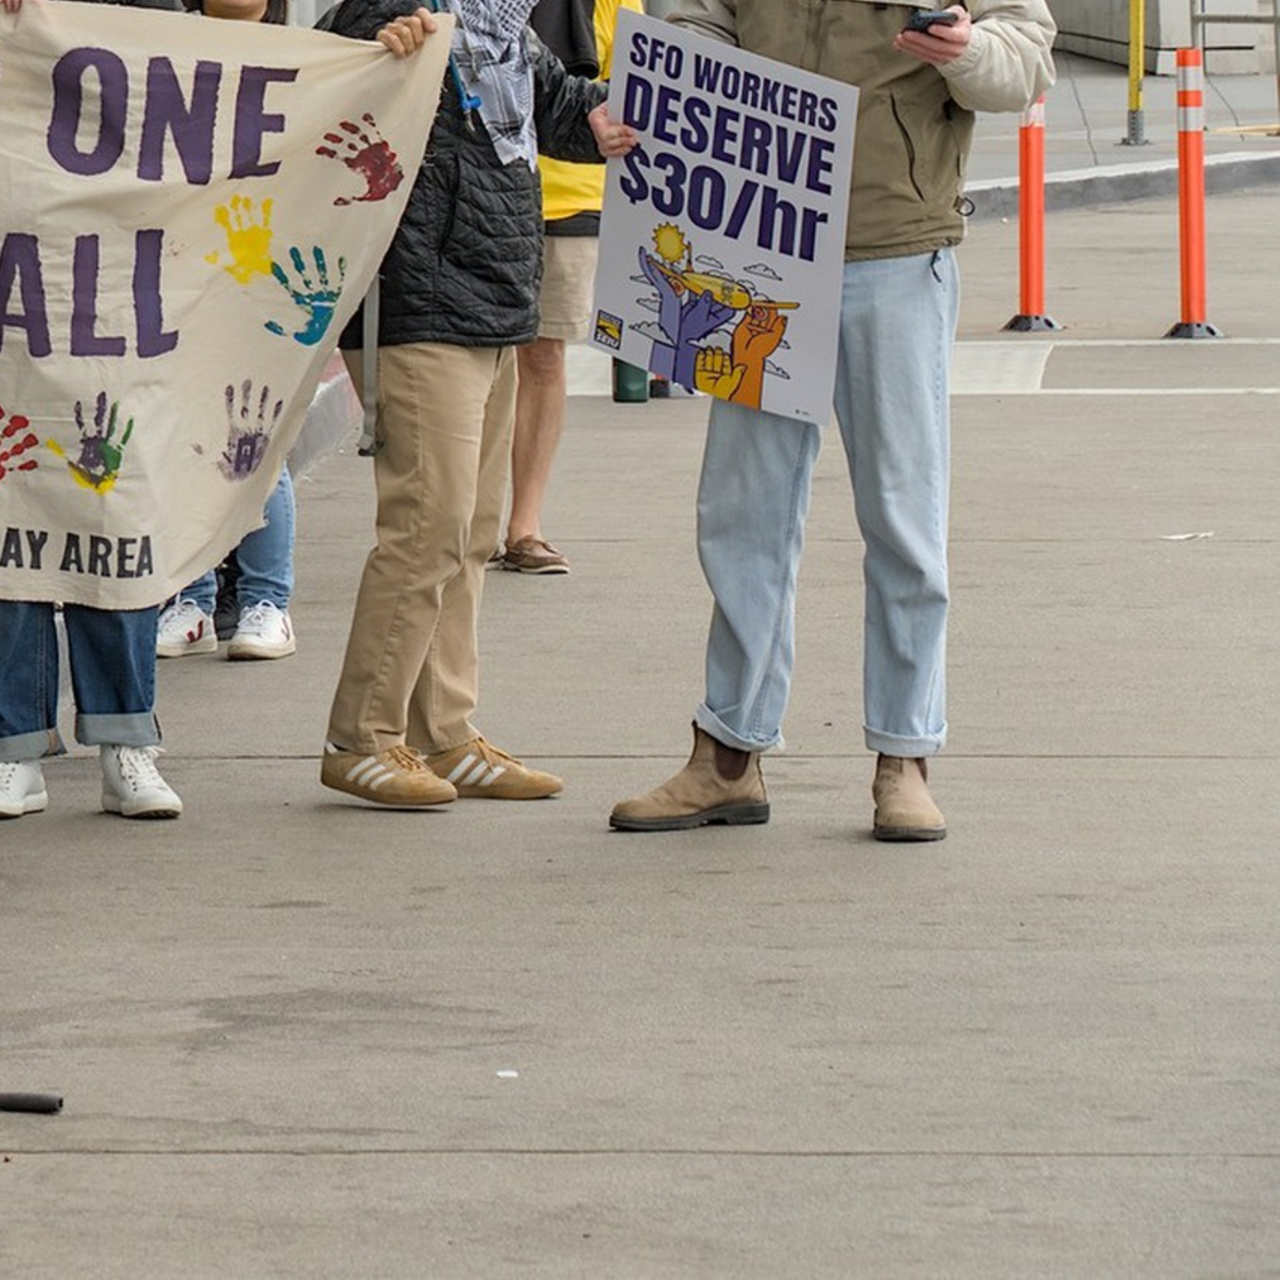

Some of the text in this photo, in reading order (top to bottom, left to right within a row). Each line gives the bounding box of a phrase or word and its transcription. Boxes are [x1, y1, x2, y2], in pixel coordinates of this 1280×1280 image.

[46, 46, 300, 186] ONE
[622, 72, 837, 196] DESERVE
[629, 31, 839, 133] SFO WORKERS
[619, 141, 830, 264] $30/hr
[60, 531, 155, 579] AREA
